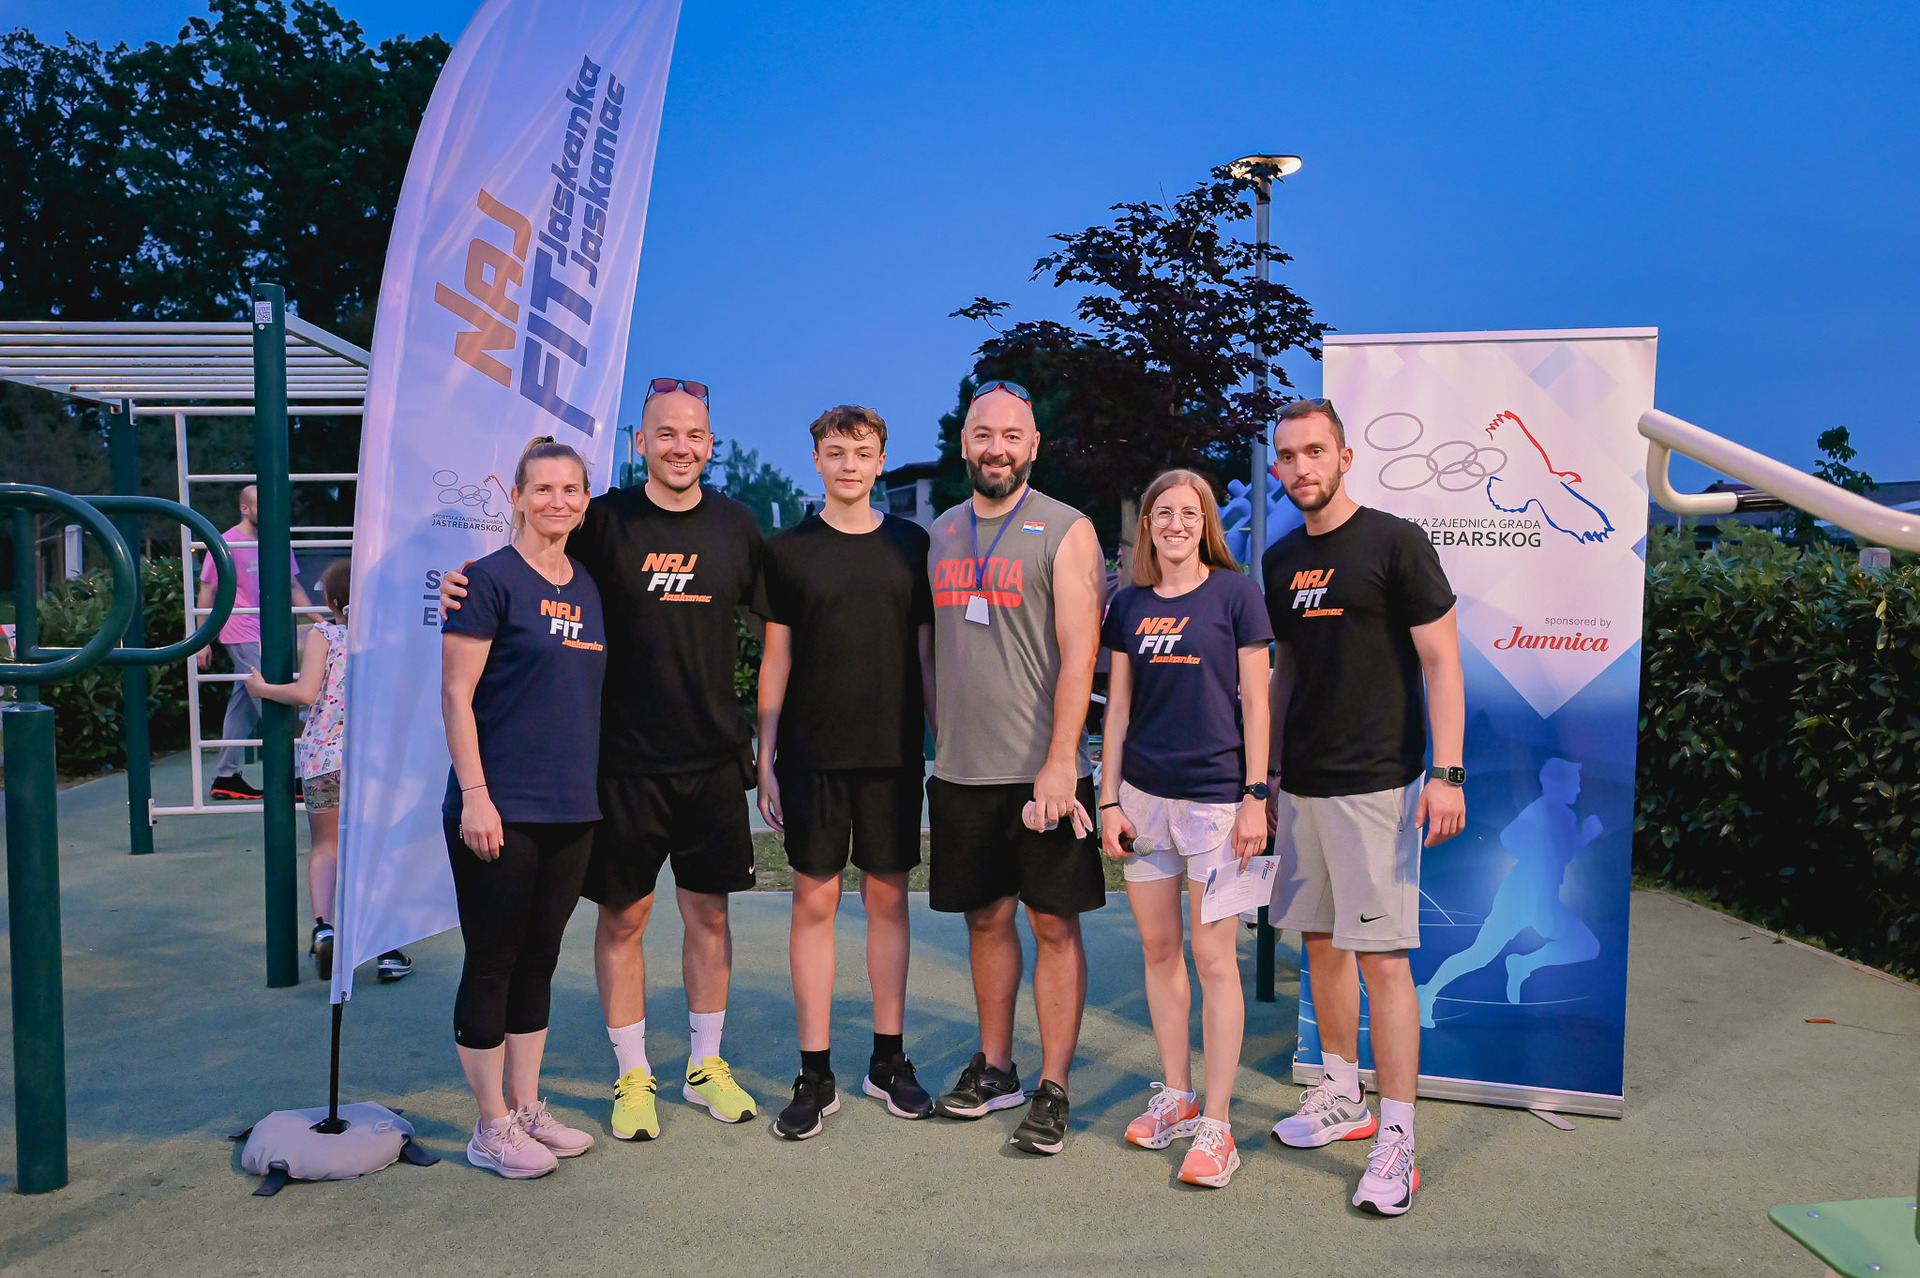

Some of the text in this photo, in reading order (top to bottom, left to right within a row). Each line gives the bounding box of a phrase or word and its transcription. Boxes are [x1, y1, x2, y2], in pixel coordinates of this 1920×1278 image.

[538, 54, 601, 267] Jaskanka
[571, 72, 625, 288] Jaskanac
[434, 187, 532, 388] NAJ
[520, 247, 596, 438] FIT
[432, 519, 503, 533] JASTREBARSKOG
[1431, 518, 1496, 529] ZAJEDNICA
[1499, 519, 1541, 529] GRADA
[1430, 530, 1541, 548] EBARSKOG
[641, 553, 698, 573] NAJ
[647, 572, 694, 592] FIT
[1289, 568, 1335, 590] NAJ
[1292, 587, 1328, 609] FIT
[540, 599, 581, 622] NAJ
[550, 617, 583, 639] FIT
[1135, 616, 1190, 635] NAJ
[1545, 617, 1612, 629] sponsored by
[1138, 634, 1183, 654] FIT
[1493, 626, 1610, 652] Jamnica
